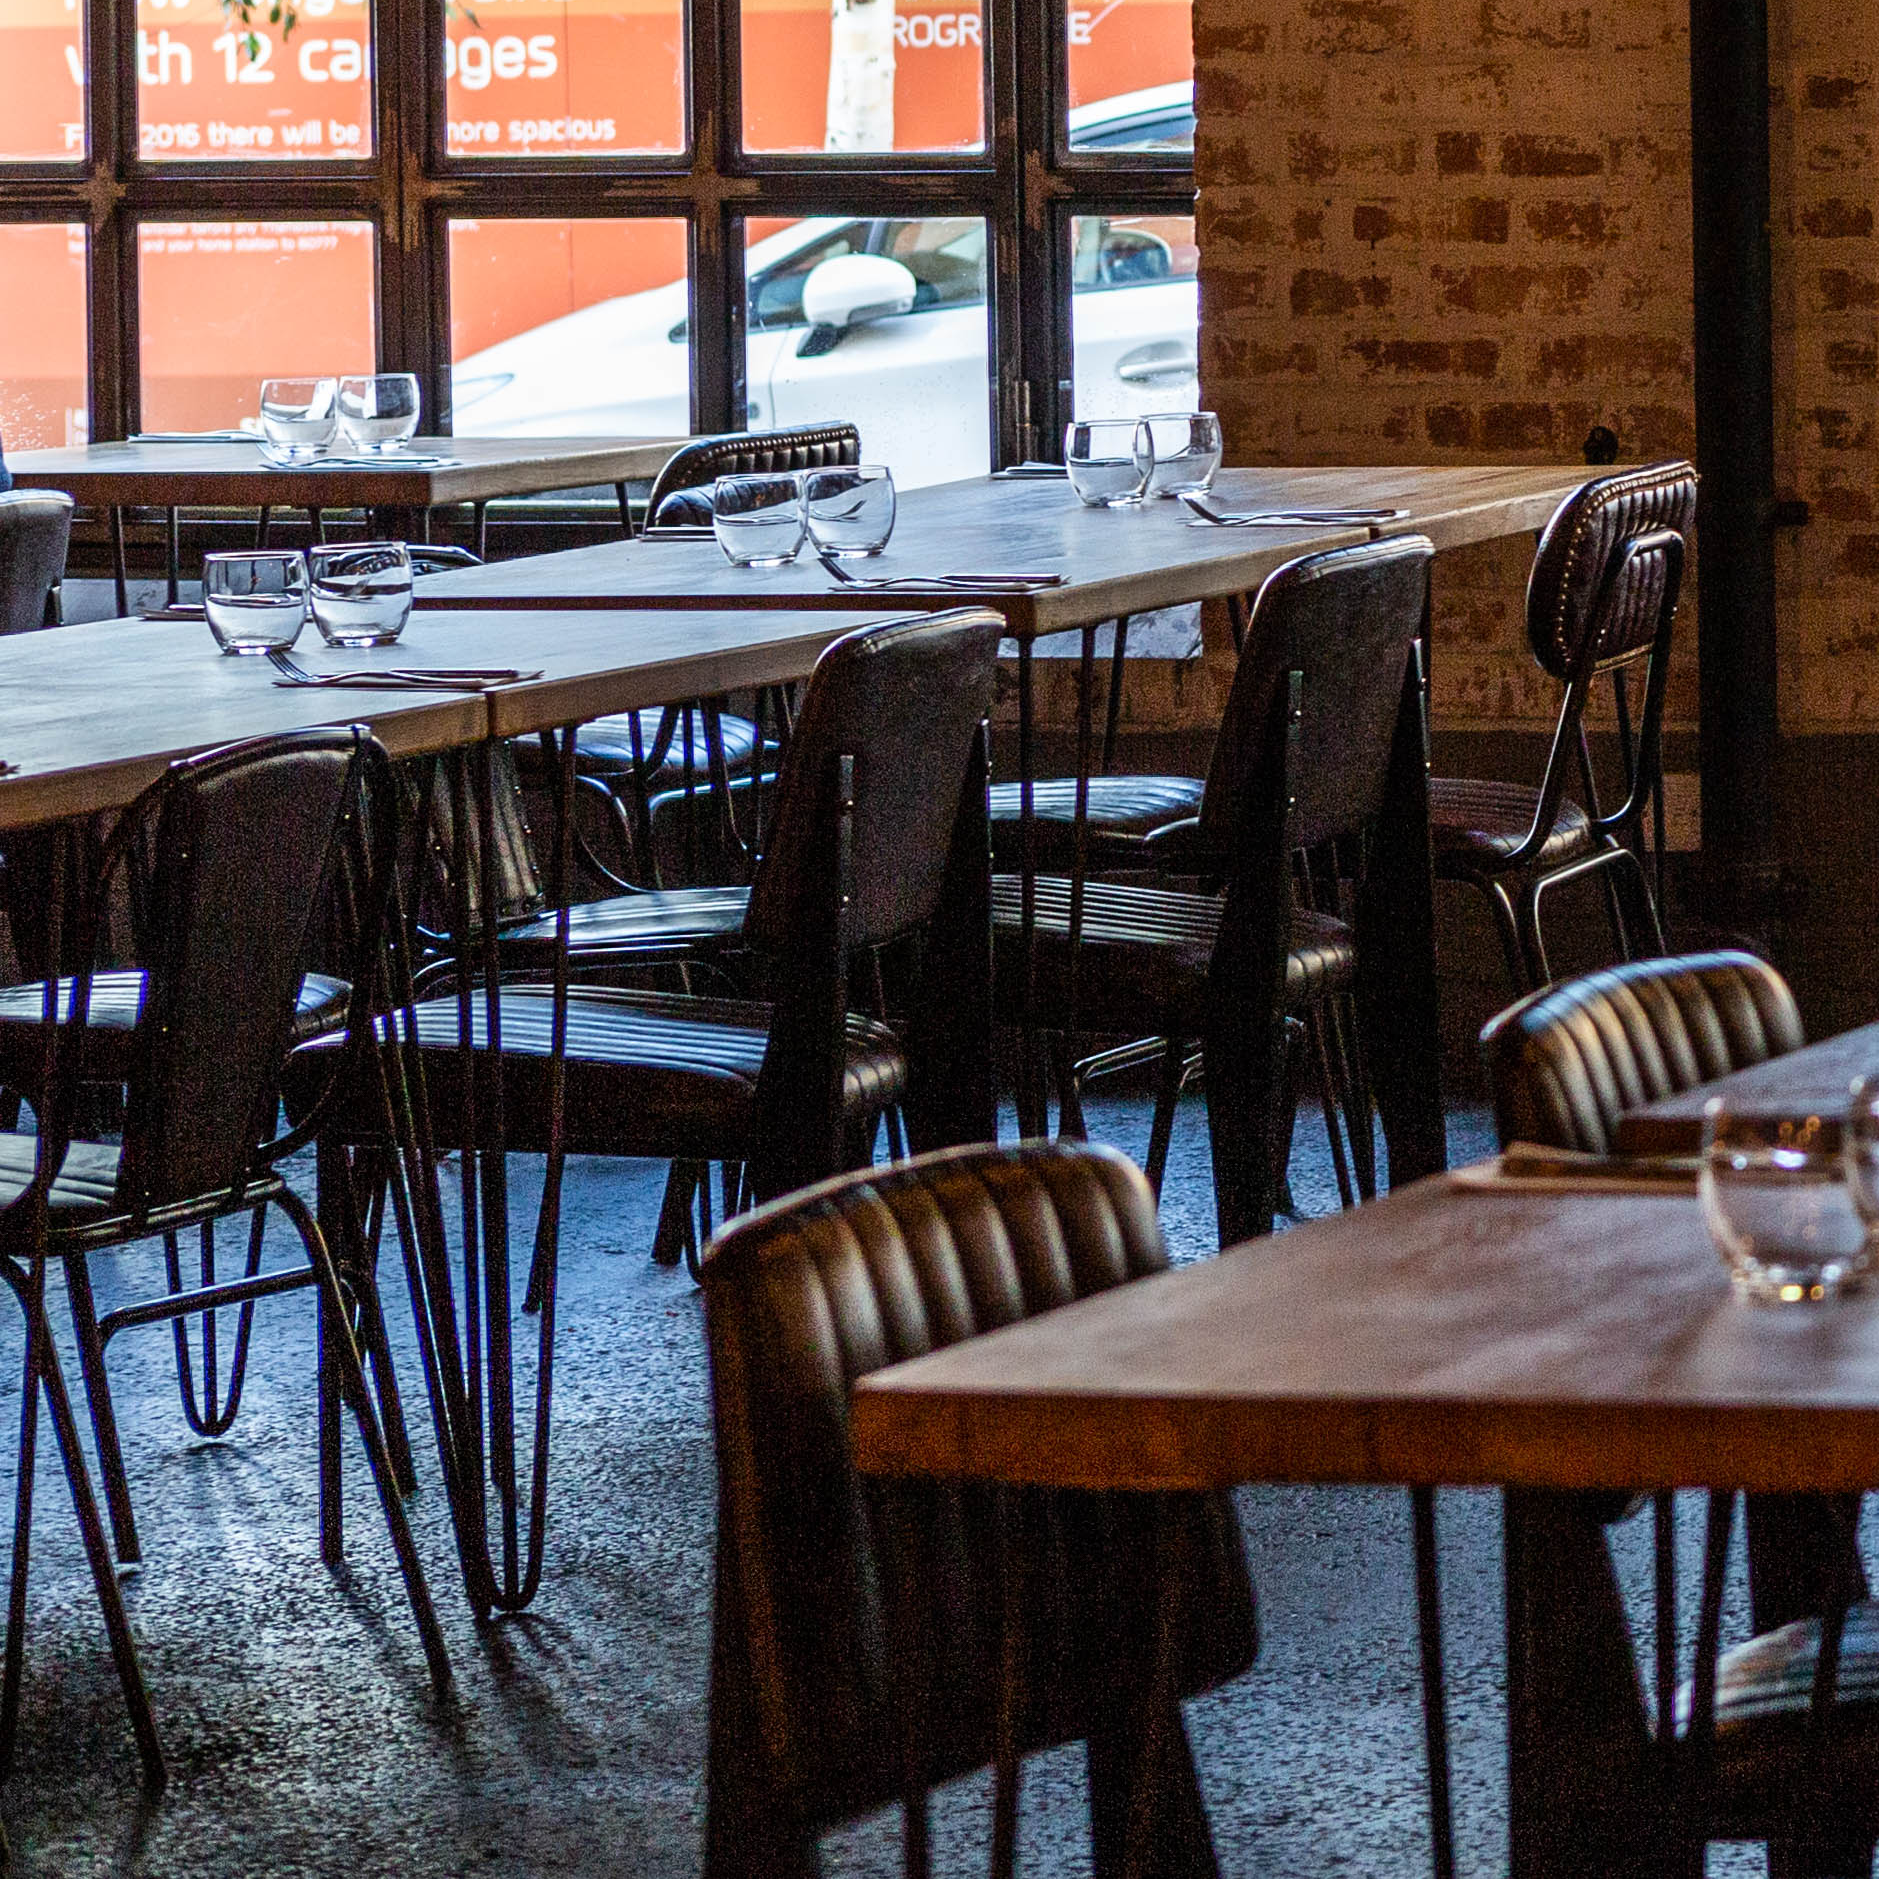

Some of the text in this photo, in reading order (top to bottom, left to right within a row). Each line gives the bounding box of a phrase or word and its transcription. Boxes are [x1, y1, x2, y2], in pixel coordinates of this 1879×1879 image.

[212, 31, 275, 84] 12
[207, 122, 273, 147] there
[281, 120, 321, 146] will
[328, 119, 360, 144] be
[508, 118, 616, 150] spacious
